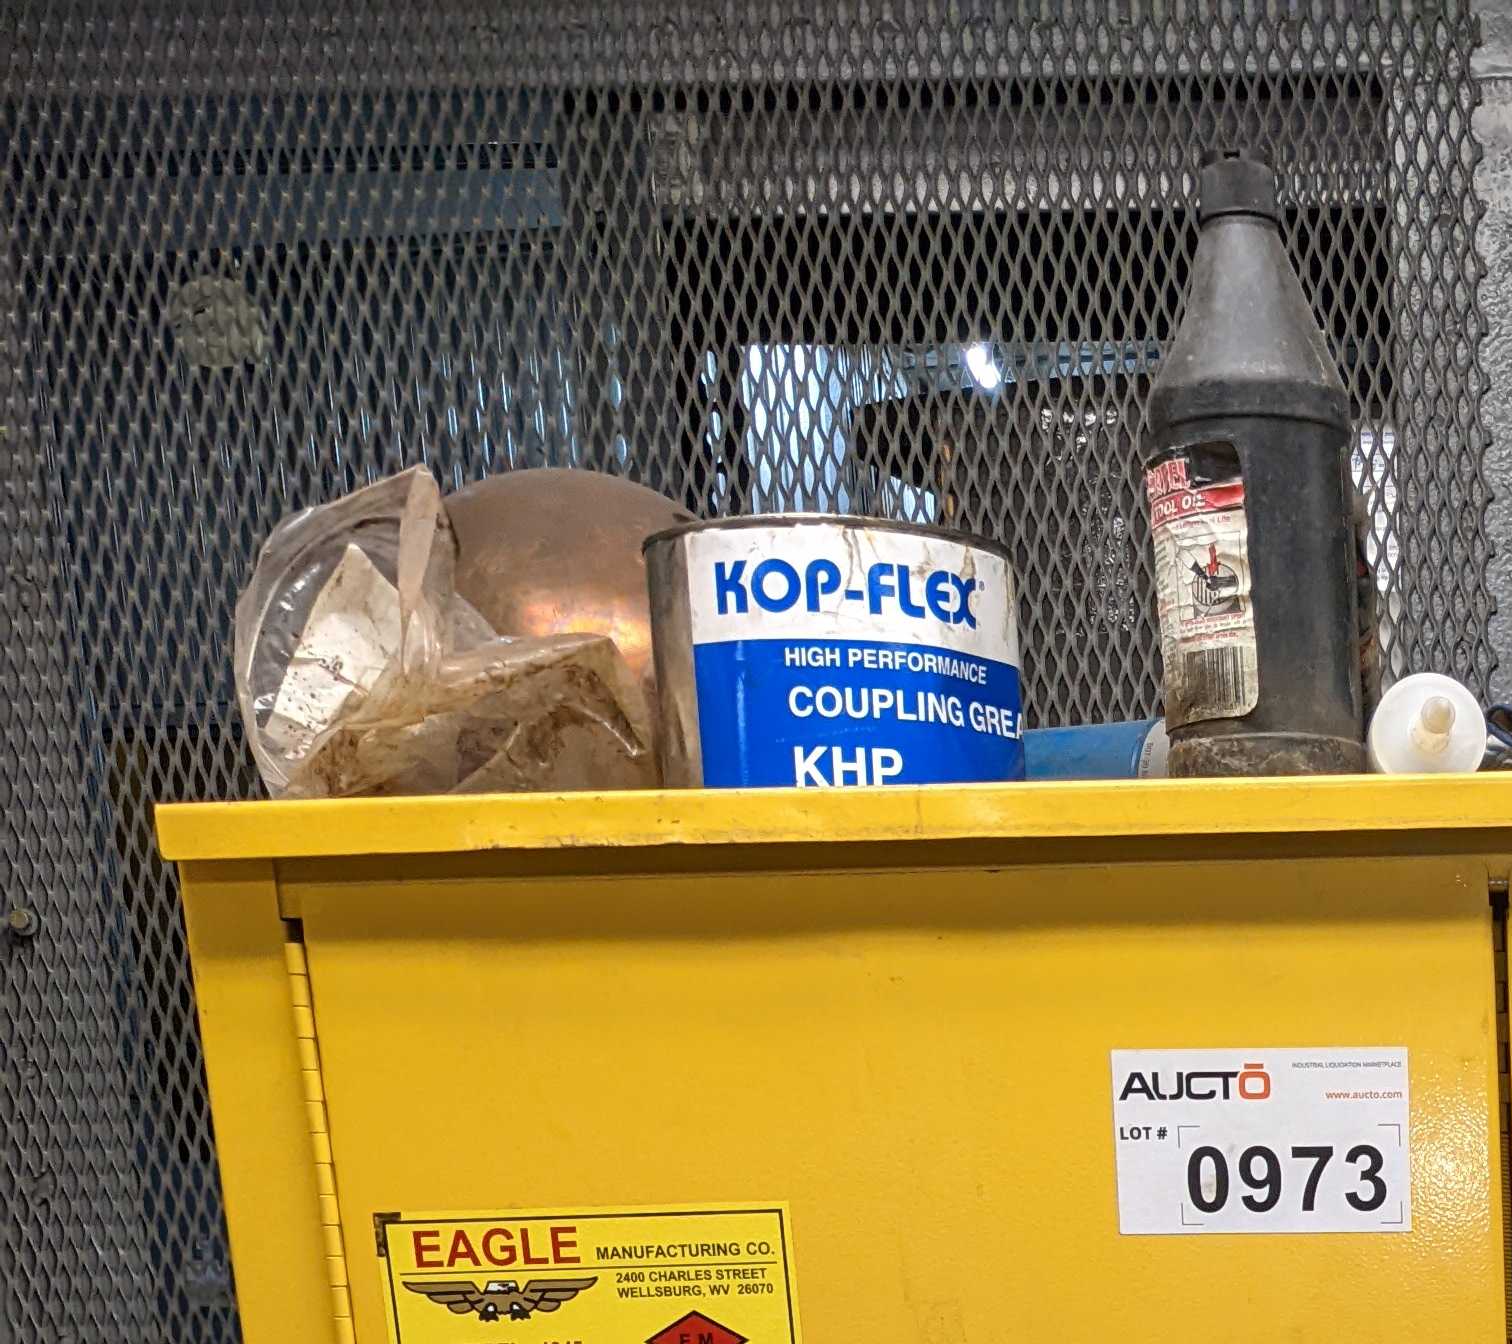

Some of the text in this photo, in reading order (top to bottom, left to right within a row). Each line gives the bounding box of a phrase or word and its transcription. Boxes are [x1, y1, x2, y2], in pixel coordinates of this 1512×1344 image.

[785, 647, 987, 684] HIGH PERFORMANCE
[788, 685, 965, 727] COUPLING
[793, 745, 904, 787] KHP
[1325, 1089, 1403, 1100] www.aucto.com
[1120, 1127, 1168, 1140] LOT #
[1187, 1144, 1387, 1214] 0973
[412, 1226, 775, 1268] EAGLE MANUFACTURING CO.
[616, 1268, 767, 1283] 2400 CHARLES STREET
[617, 1283, 774, 1298] WELLSBURG, WV 26070
